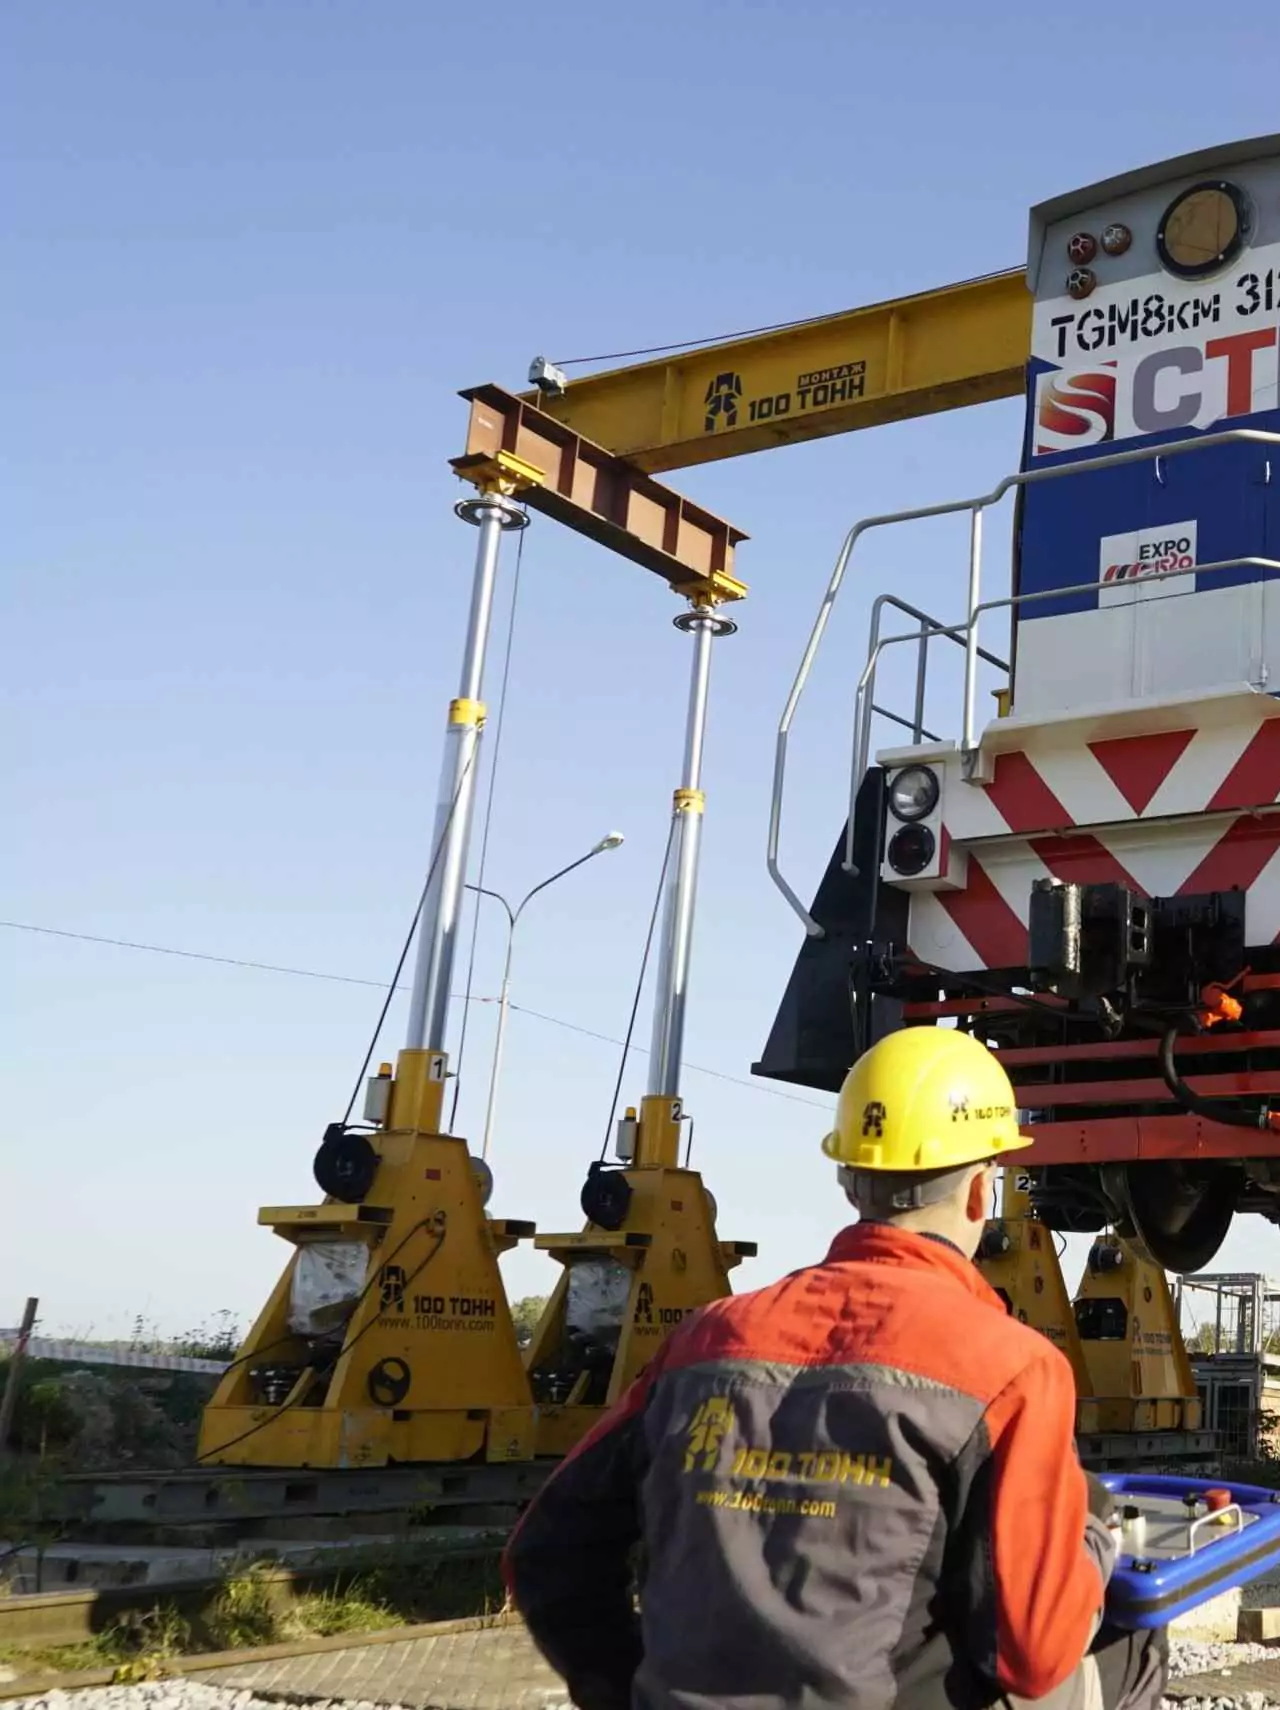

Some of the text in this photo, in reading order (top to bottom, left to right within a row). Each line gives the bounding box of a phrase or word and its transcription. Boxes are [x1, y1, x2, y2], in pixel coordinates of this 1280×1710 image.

[800, 362, 864, 386] МОНТАЖ
[748, 375, 865, 421] 100 ТОНН
[1139, 537, 1190, 561] EXPO
[434, 1058, 443, 1079] 1
[672, 1102, 682, 1121] 2
[1018, 1176, 1029, 1190] 2
[414, 1295, 496, 1317] 100 ТОНН
[659, 1308, 682, 1324] 100
[730, 1448, 791, 1477] 100
